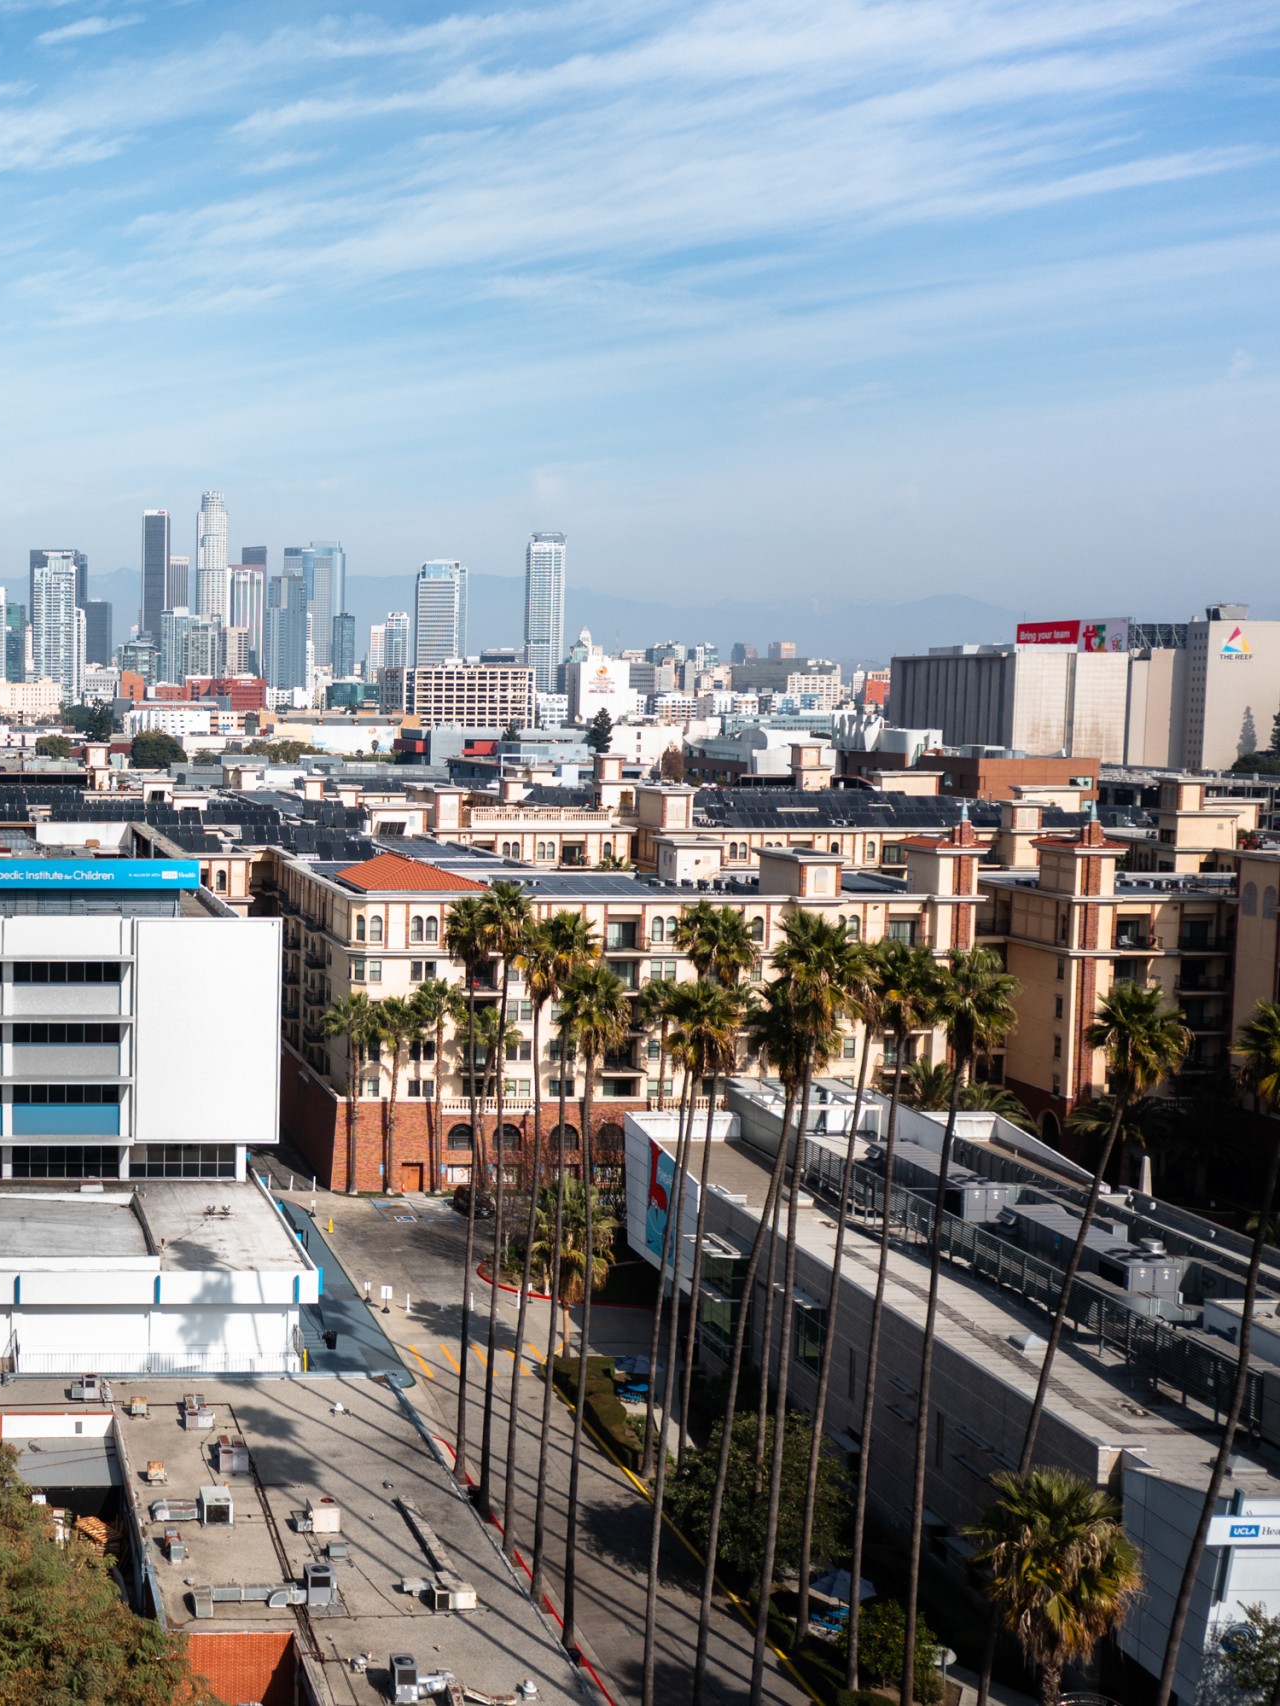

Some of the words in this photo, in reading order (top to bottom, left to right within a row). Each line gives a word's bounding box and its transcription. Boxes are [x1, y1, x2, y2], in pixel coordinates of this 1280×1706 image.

[1020, 631, 1037, 642] Bring
[1038, 632, 1053, 641] your
[1053, 630, 1070, 638] team
[25, 871, 63, 880] Institute
[73, 870, 115, 880] Children
[1233, 1527, 1257, 1535] UCLA
